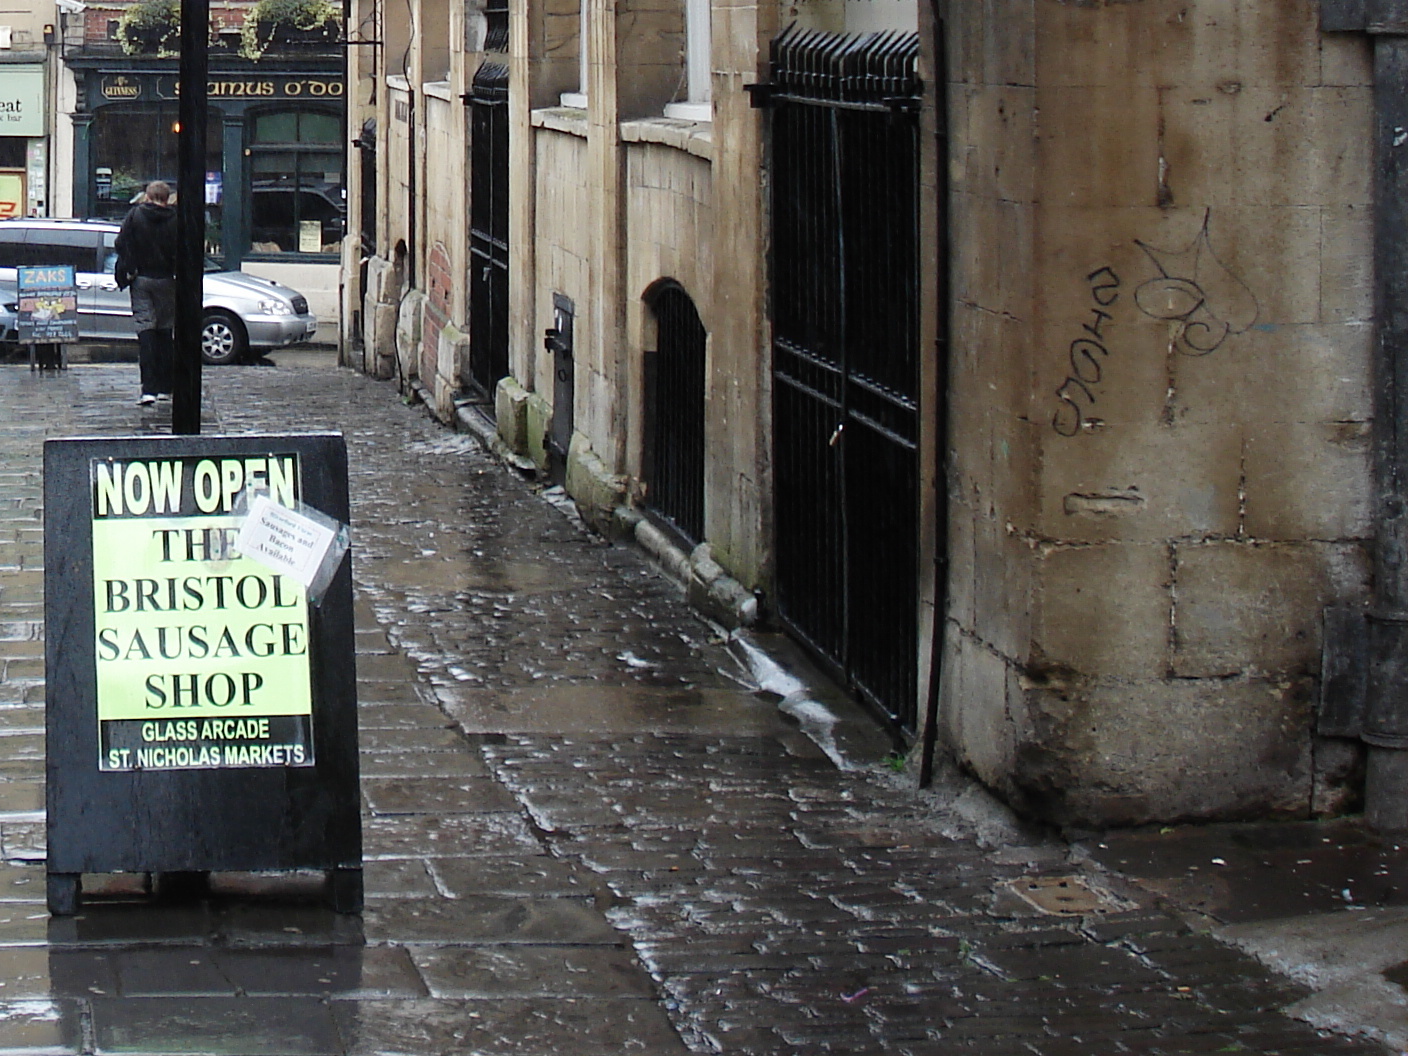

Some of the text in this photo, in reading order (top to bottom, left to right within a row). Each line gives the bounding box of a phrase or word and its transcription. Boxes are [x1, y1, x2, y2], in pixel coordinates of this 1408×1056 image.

[105, 86, 138, 96] GUINNESS
[7, 113, 22, 122] bar
[23, 268, 66, 284] ZAKS
[96, 457, 293, 516] NOW OPEN
[152, 527, 244, 563] THE
[260, 516, 296, 540] Sausages
[297, 537, 314, 549] and
[268, 534, 294, 553] Bacon
[259, 543, 296, 566] Available
[103, 574, 299, 614] BRISTOL
[98, 622, 307, 662] SAUSAGE
[144, 671, 265, 710] SHOP
[142, 718, 270, 742] GLASS ARCADE
[108, 744, 306, 769] ST. NICHOLAS MARKETS
